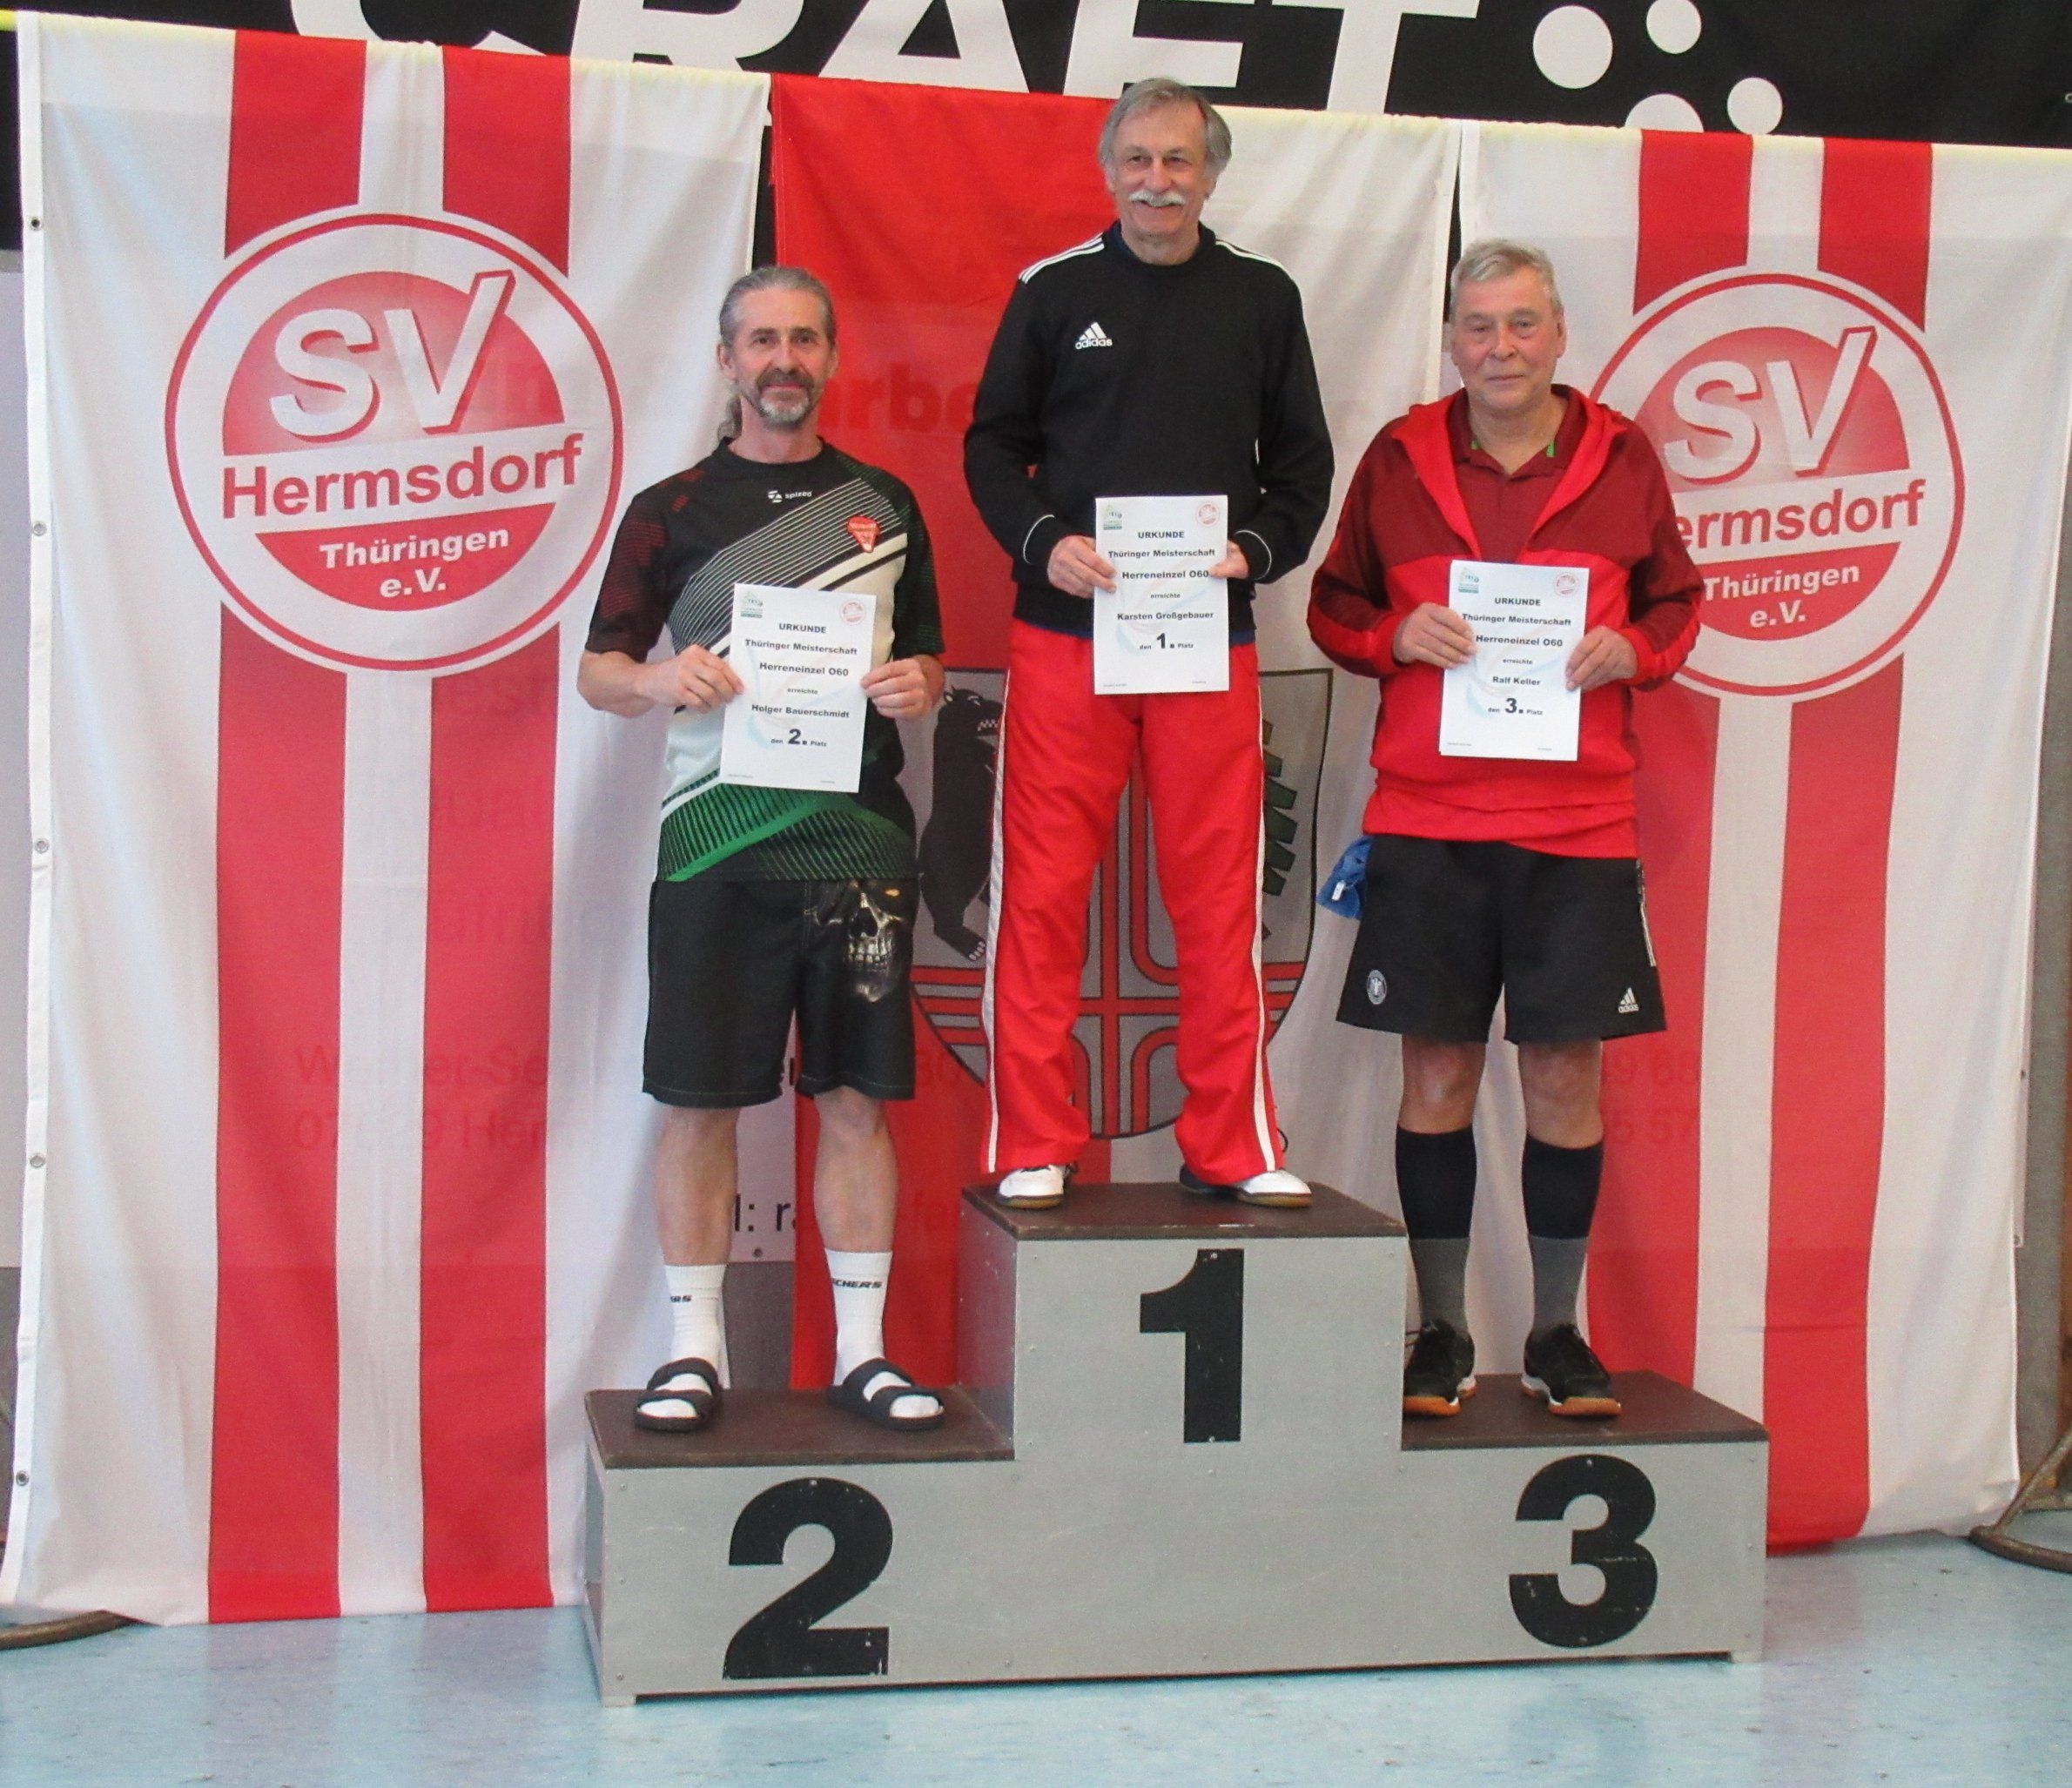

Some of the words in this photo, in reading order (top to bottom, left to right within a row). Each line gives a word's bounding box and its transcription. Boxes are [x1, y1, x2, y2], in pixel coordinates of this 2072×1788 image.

[292, 0, 1477, 115] RAFT
[1075, 339, 1113, 350] adidas
[270, 268, 516, 441] SV
[1664, 326, 1878, 485] SV
[223, 434, 583, 519] Hermsdorf
[784, 490, 812, 500] spized
[1676, 478, 1926, 549] ermsdorf
[320, 528, 509, 570] Thüringen
[1108, 550, 1150, 559] Thüringer
[1154, 549, 1215, 558] Meisterschaft
[380, 568, 447, 598] e.V.
[1122, 570, 1186, 580] Herreneinzel
[1705, 565, 1860, 602] Thüringen
[1495, 597, 1541, 607] URKUNDE
[1156, 611, 1214, 622] Großgebauer
[1462, 613, 1505, 623] Thüringer
[1508, 615, 1571, 626] Meisterschaft
[1749, 600, 1806, 629] e.V.
[779, 622, 827, 634] URKUNDE
[745, 639, 790, 651] Thüringer
[793, 642, 858, 655] Meisterschaft
[1156, 633, 1174, 649] 1.
[1476, 635, 1540, 646] Herreneinzel
[759, 662, 825, 675] Herreneinzel
[829, 667, 849, 676] O60
[1492, 676, 1510, 684] Ralf
[1513, 677, 1541, 686] Keller
[751, 704, 783, 715] Holger
[785, 707, 850, 718] Bauerschmidt
[1504, 697, 1524, 714] 3.
[788, 729, 808, 745] 2.
[1138, 1248, 1245, 1444] 1
[1508, 1453, 1658, 1649] 3
[723, 1476, 894, 1680] 2
